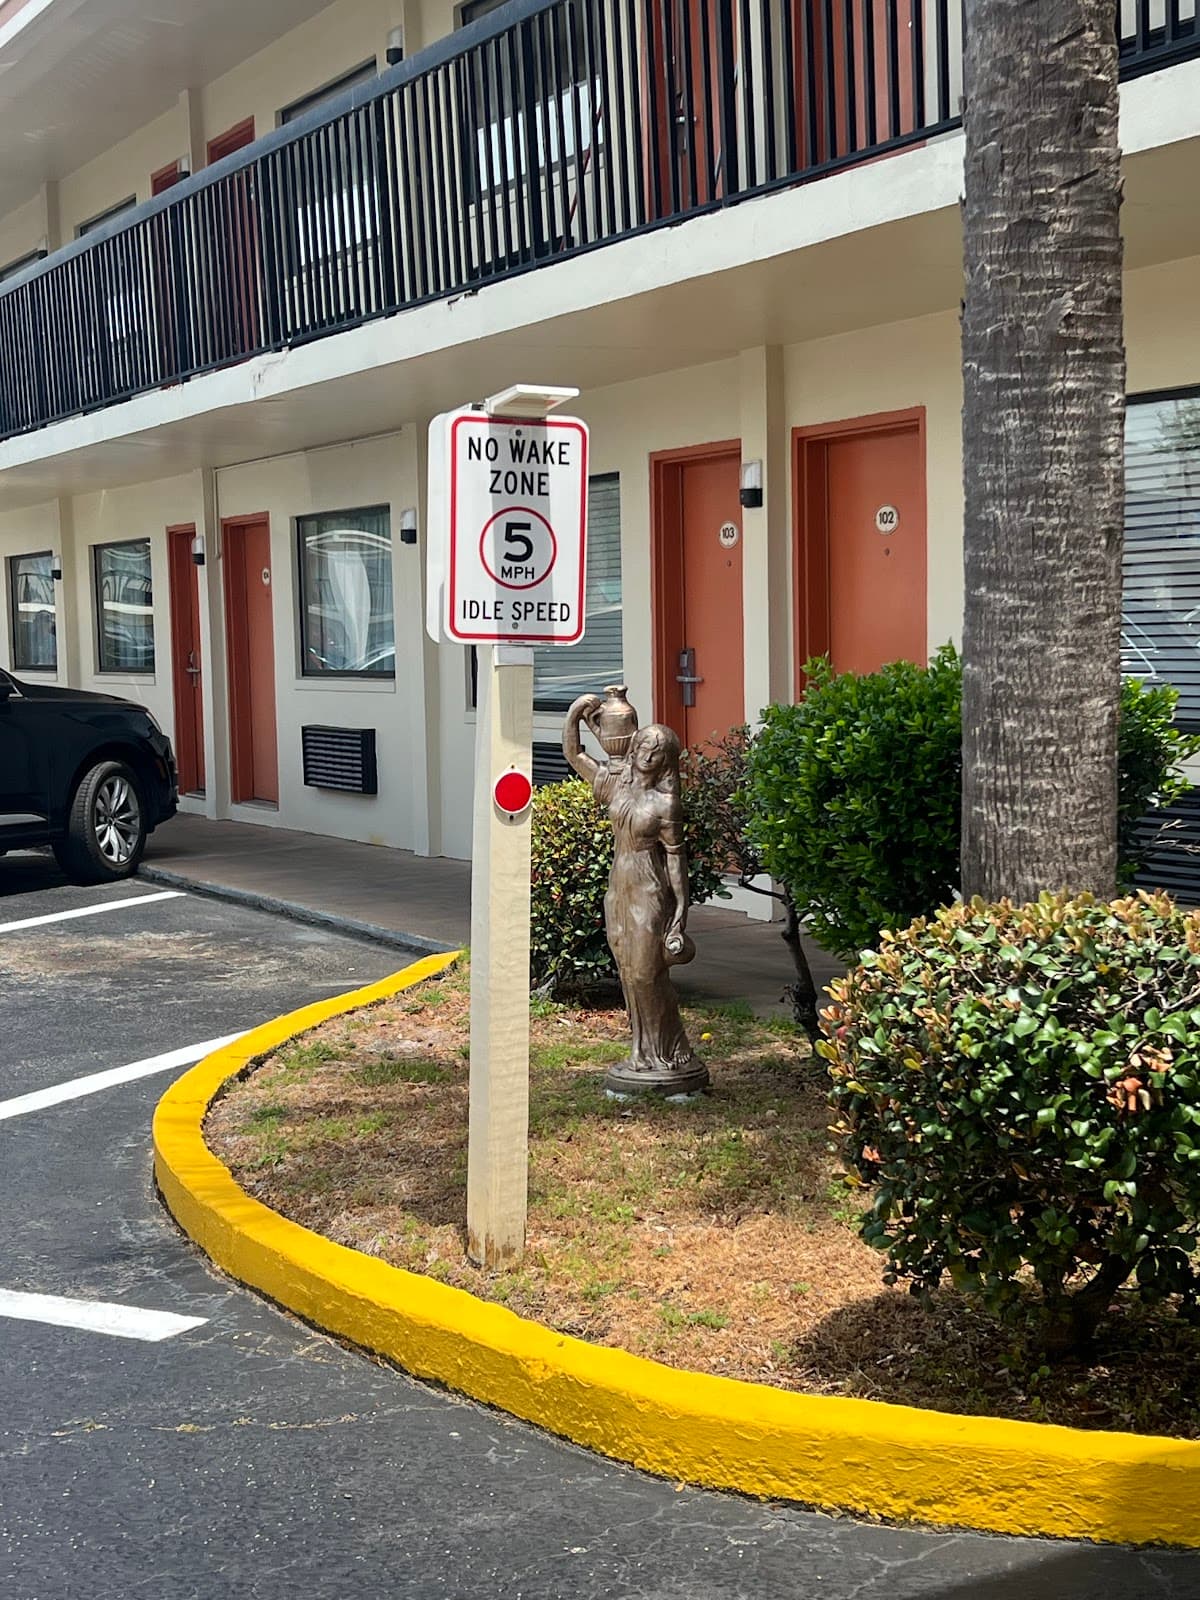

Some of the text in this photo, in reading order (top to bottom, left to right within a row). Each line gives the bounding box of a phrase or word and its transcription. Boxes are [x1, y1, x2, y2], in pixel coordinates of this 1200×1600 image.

[468, 437, 570, 465] NO WAKE
[489, 470, 549, 496] ZONE
[878, 511, 894, 524] 102
[503, 522, 533, 562] 5
[722, 527, 735, 539] 103
[501, 566, 535, 579] MPH
[463, 600, 570, 622] IDLE SPEED
